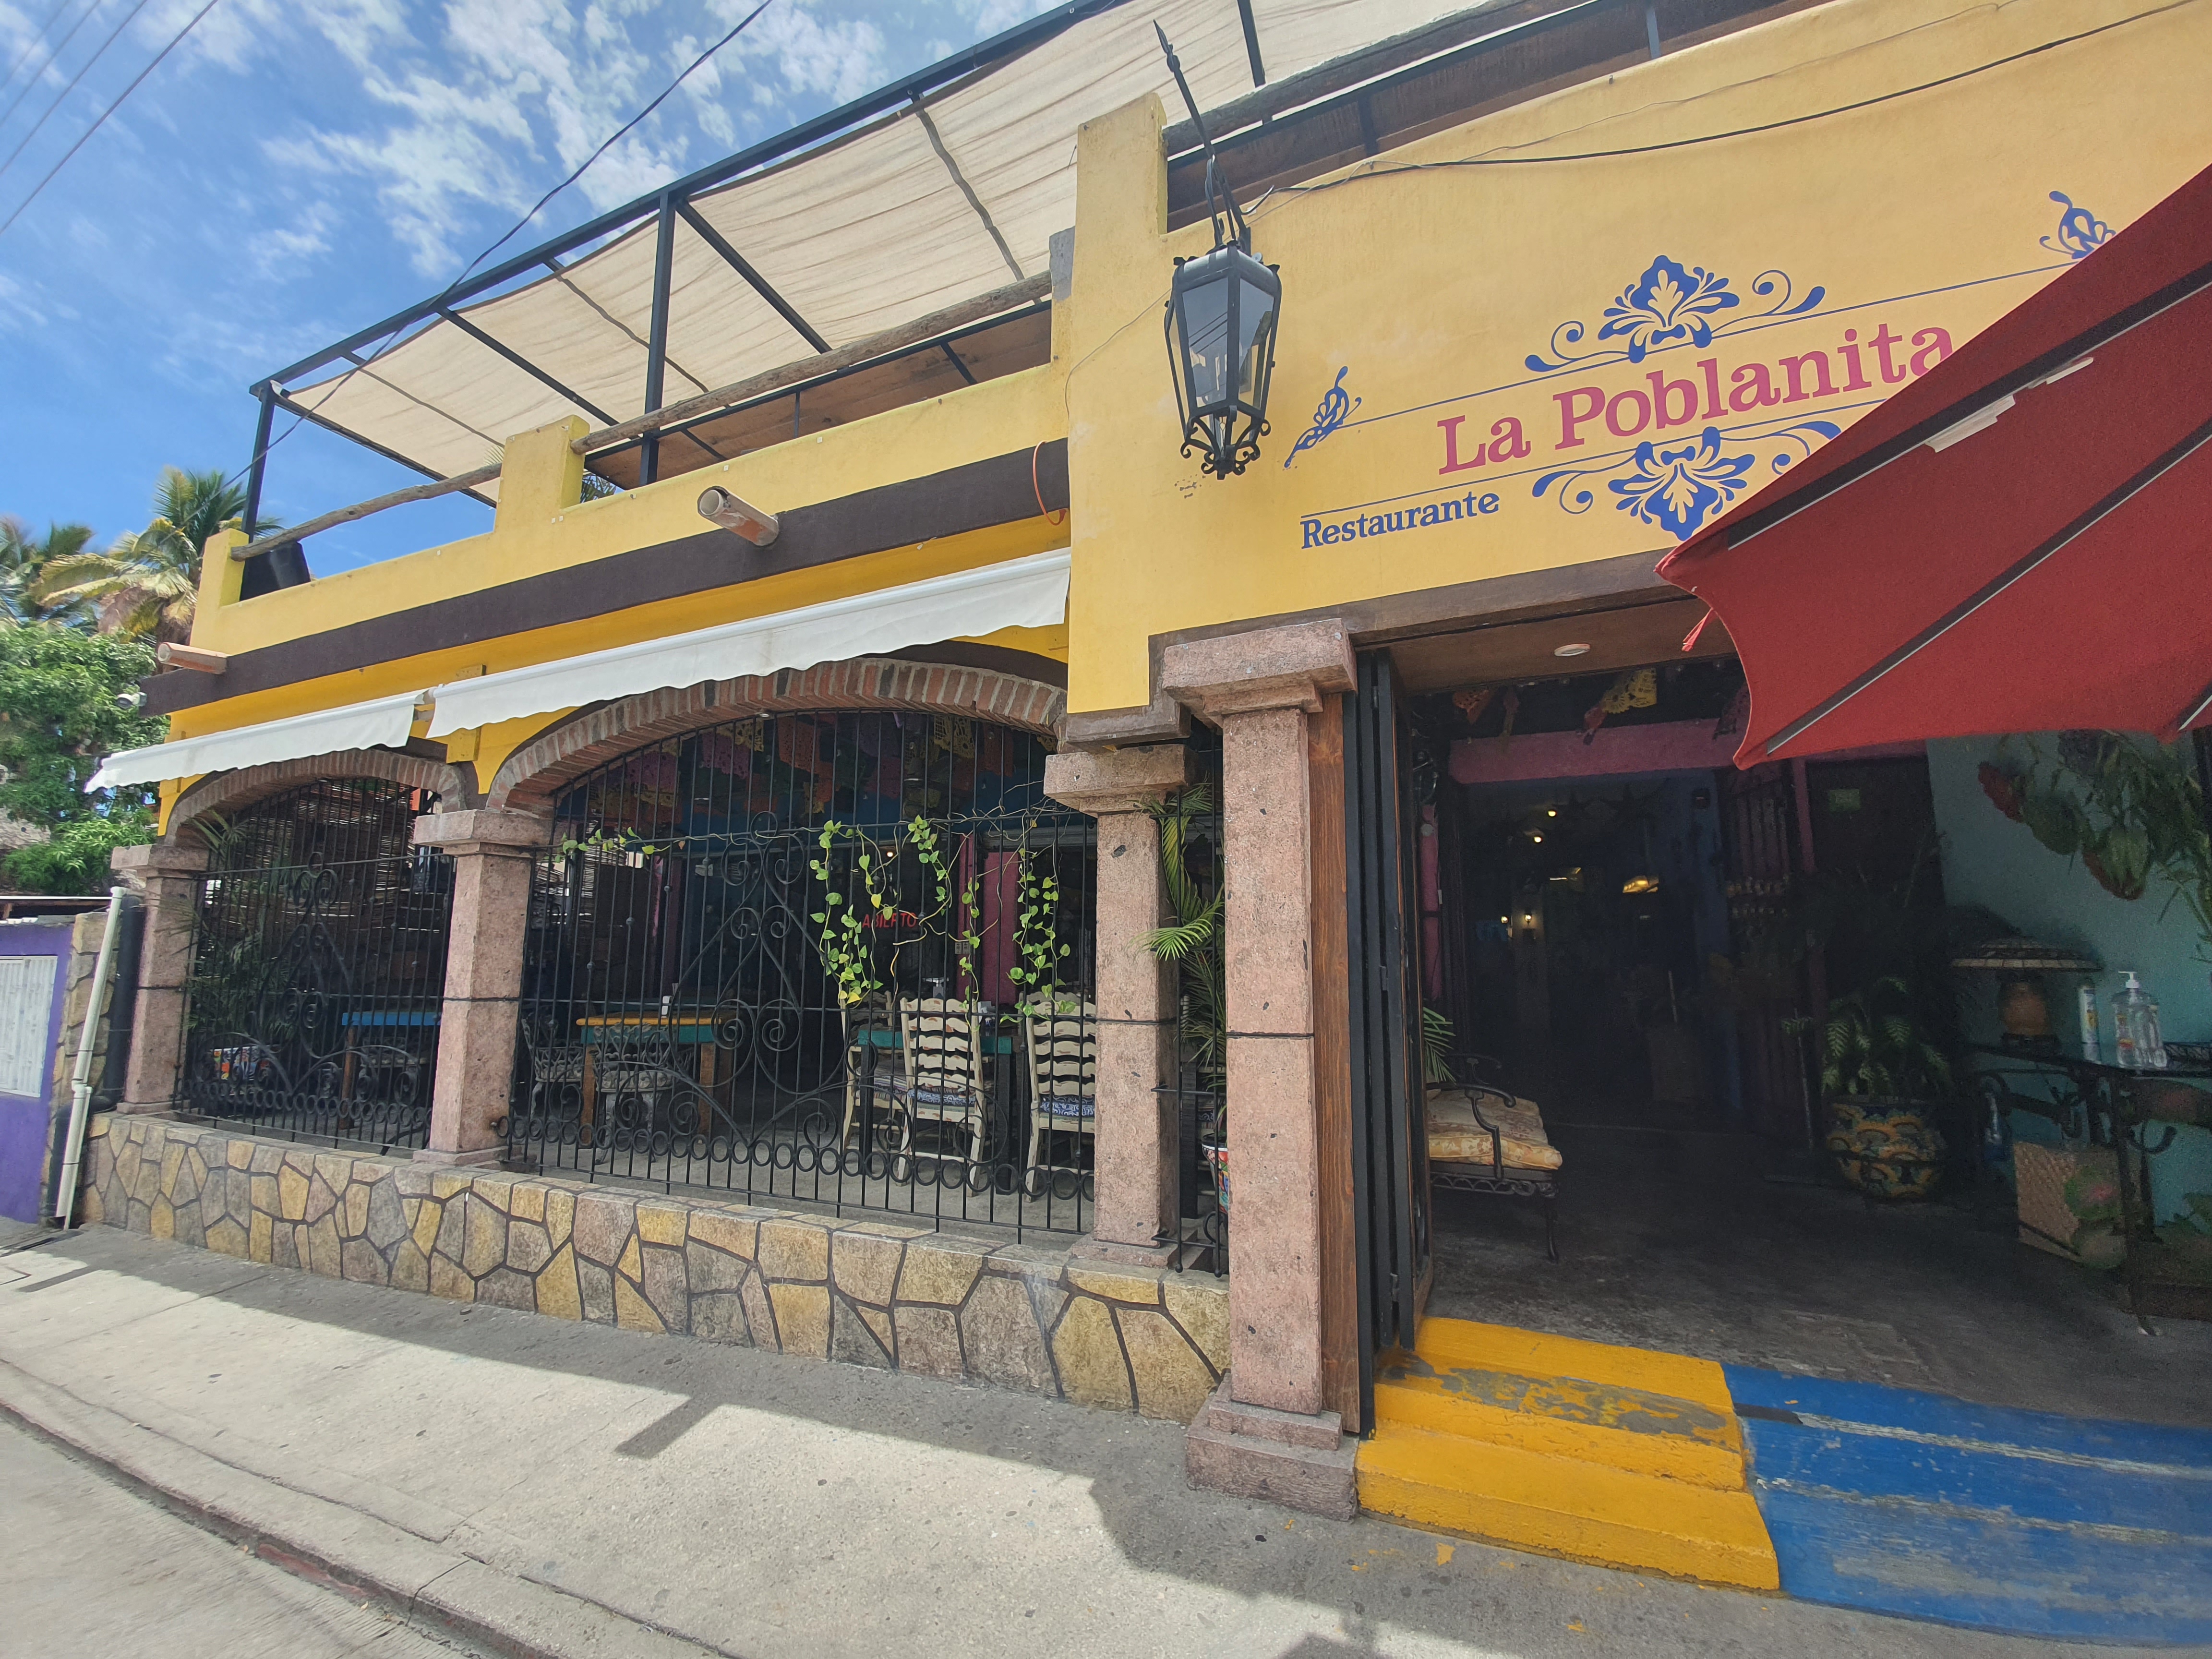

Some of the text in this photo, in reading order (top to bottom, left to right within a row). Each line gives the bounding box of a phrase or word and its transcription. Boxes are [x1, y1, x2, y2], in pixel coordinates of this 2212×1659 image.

[1438, 324, 1954, 474] La Poblanita
[1301, 492, 1500, 549] Restaurante
